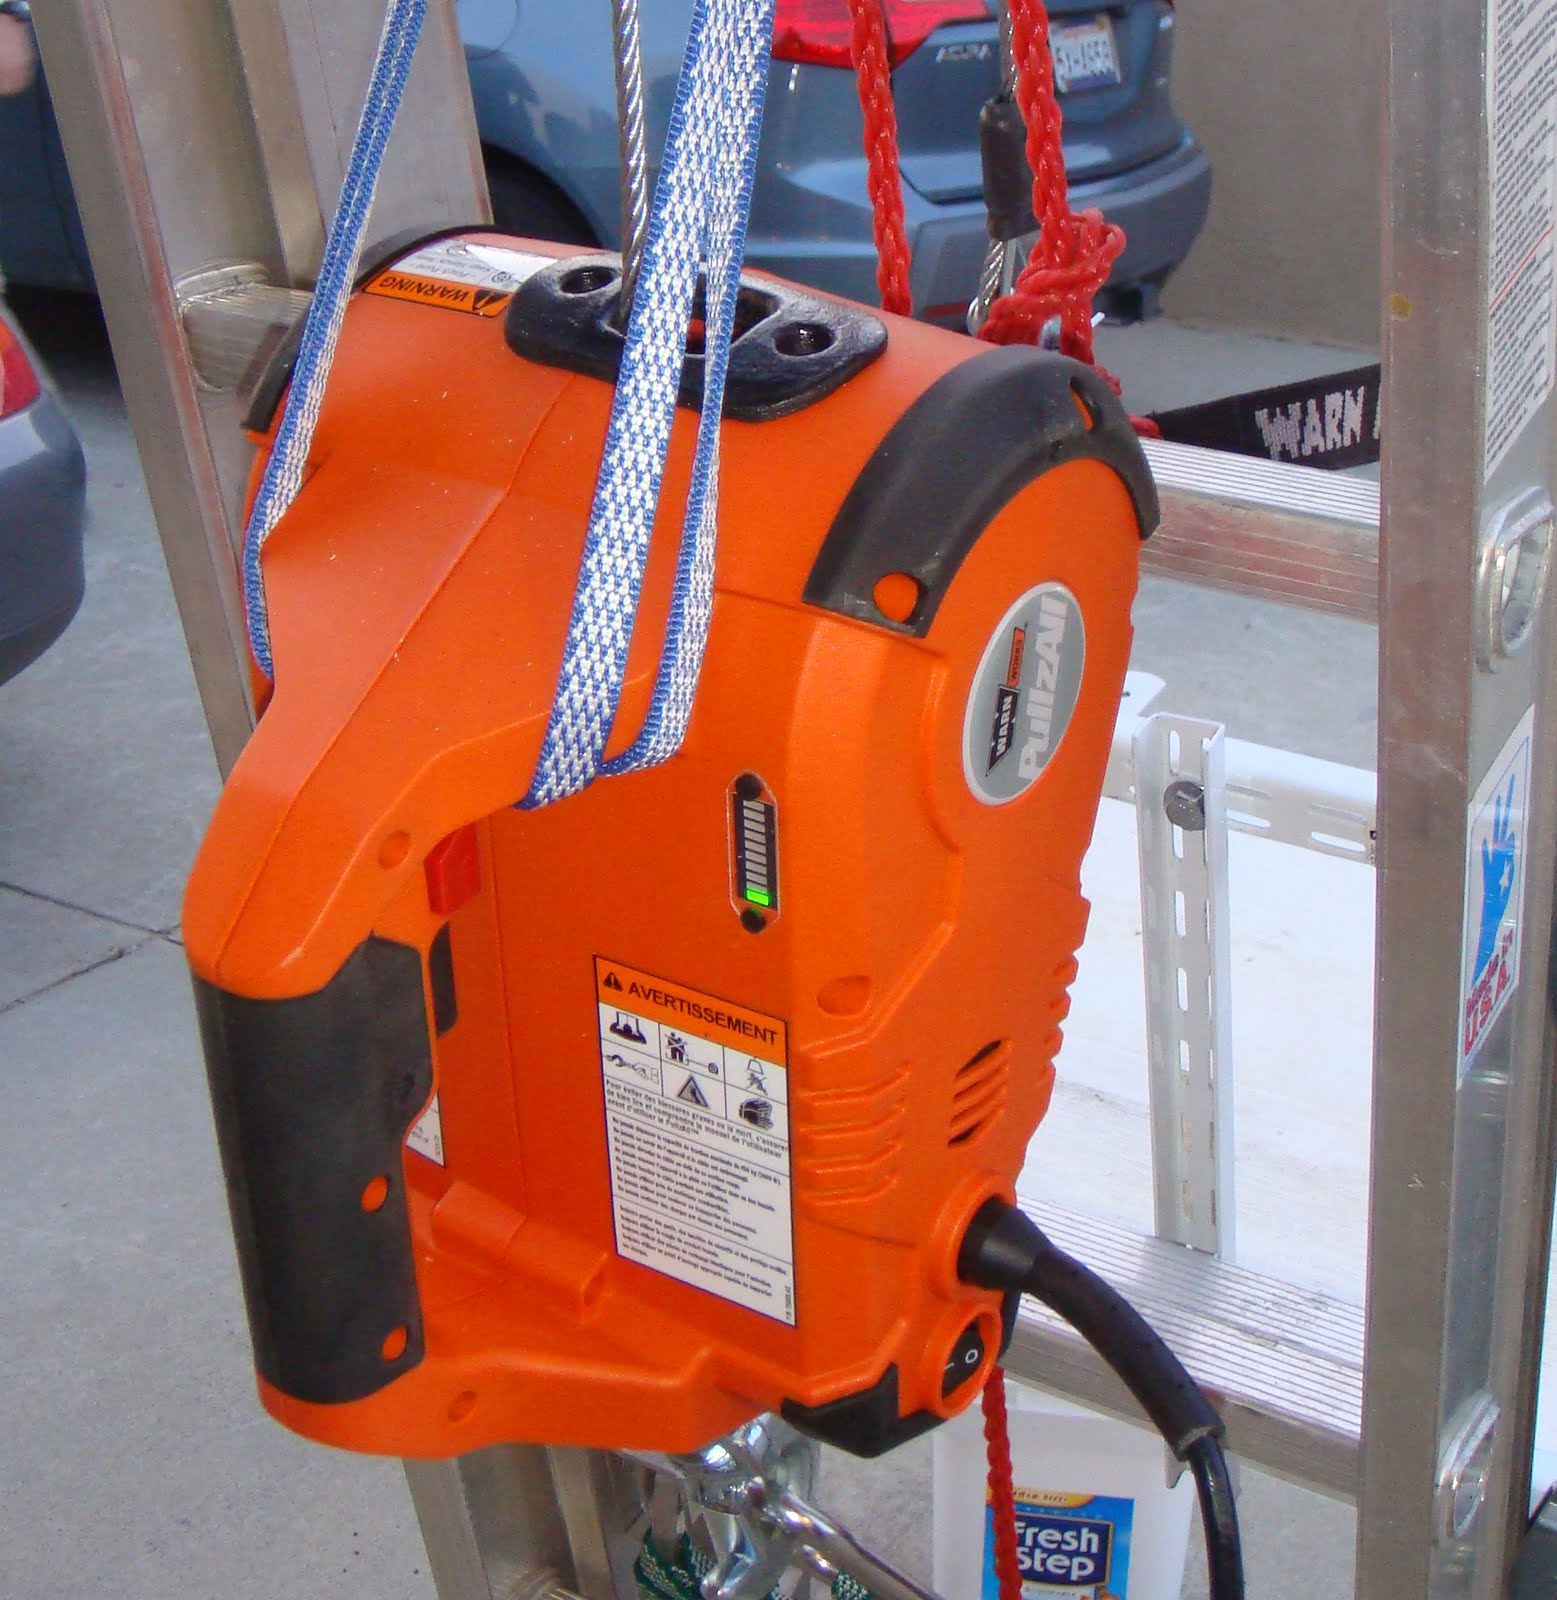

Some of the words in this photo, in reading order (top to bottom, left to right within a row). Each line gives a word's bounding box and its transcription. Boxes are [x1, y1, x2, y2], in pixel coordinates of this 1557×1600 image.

[379, 276, 469, 302] WARNING
[1254, 385, 1365, 462] WARN
[995, 695, 1014, 757] WARN
[628, 981, 778, 1046] AVERTISSEMENT
[1014, 1520, 1100, 1554] Fresh
[1016, 1546, 1096, 1582] Step
